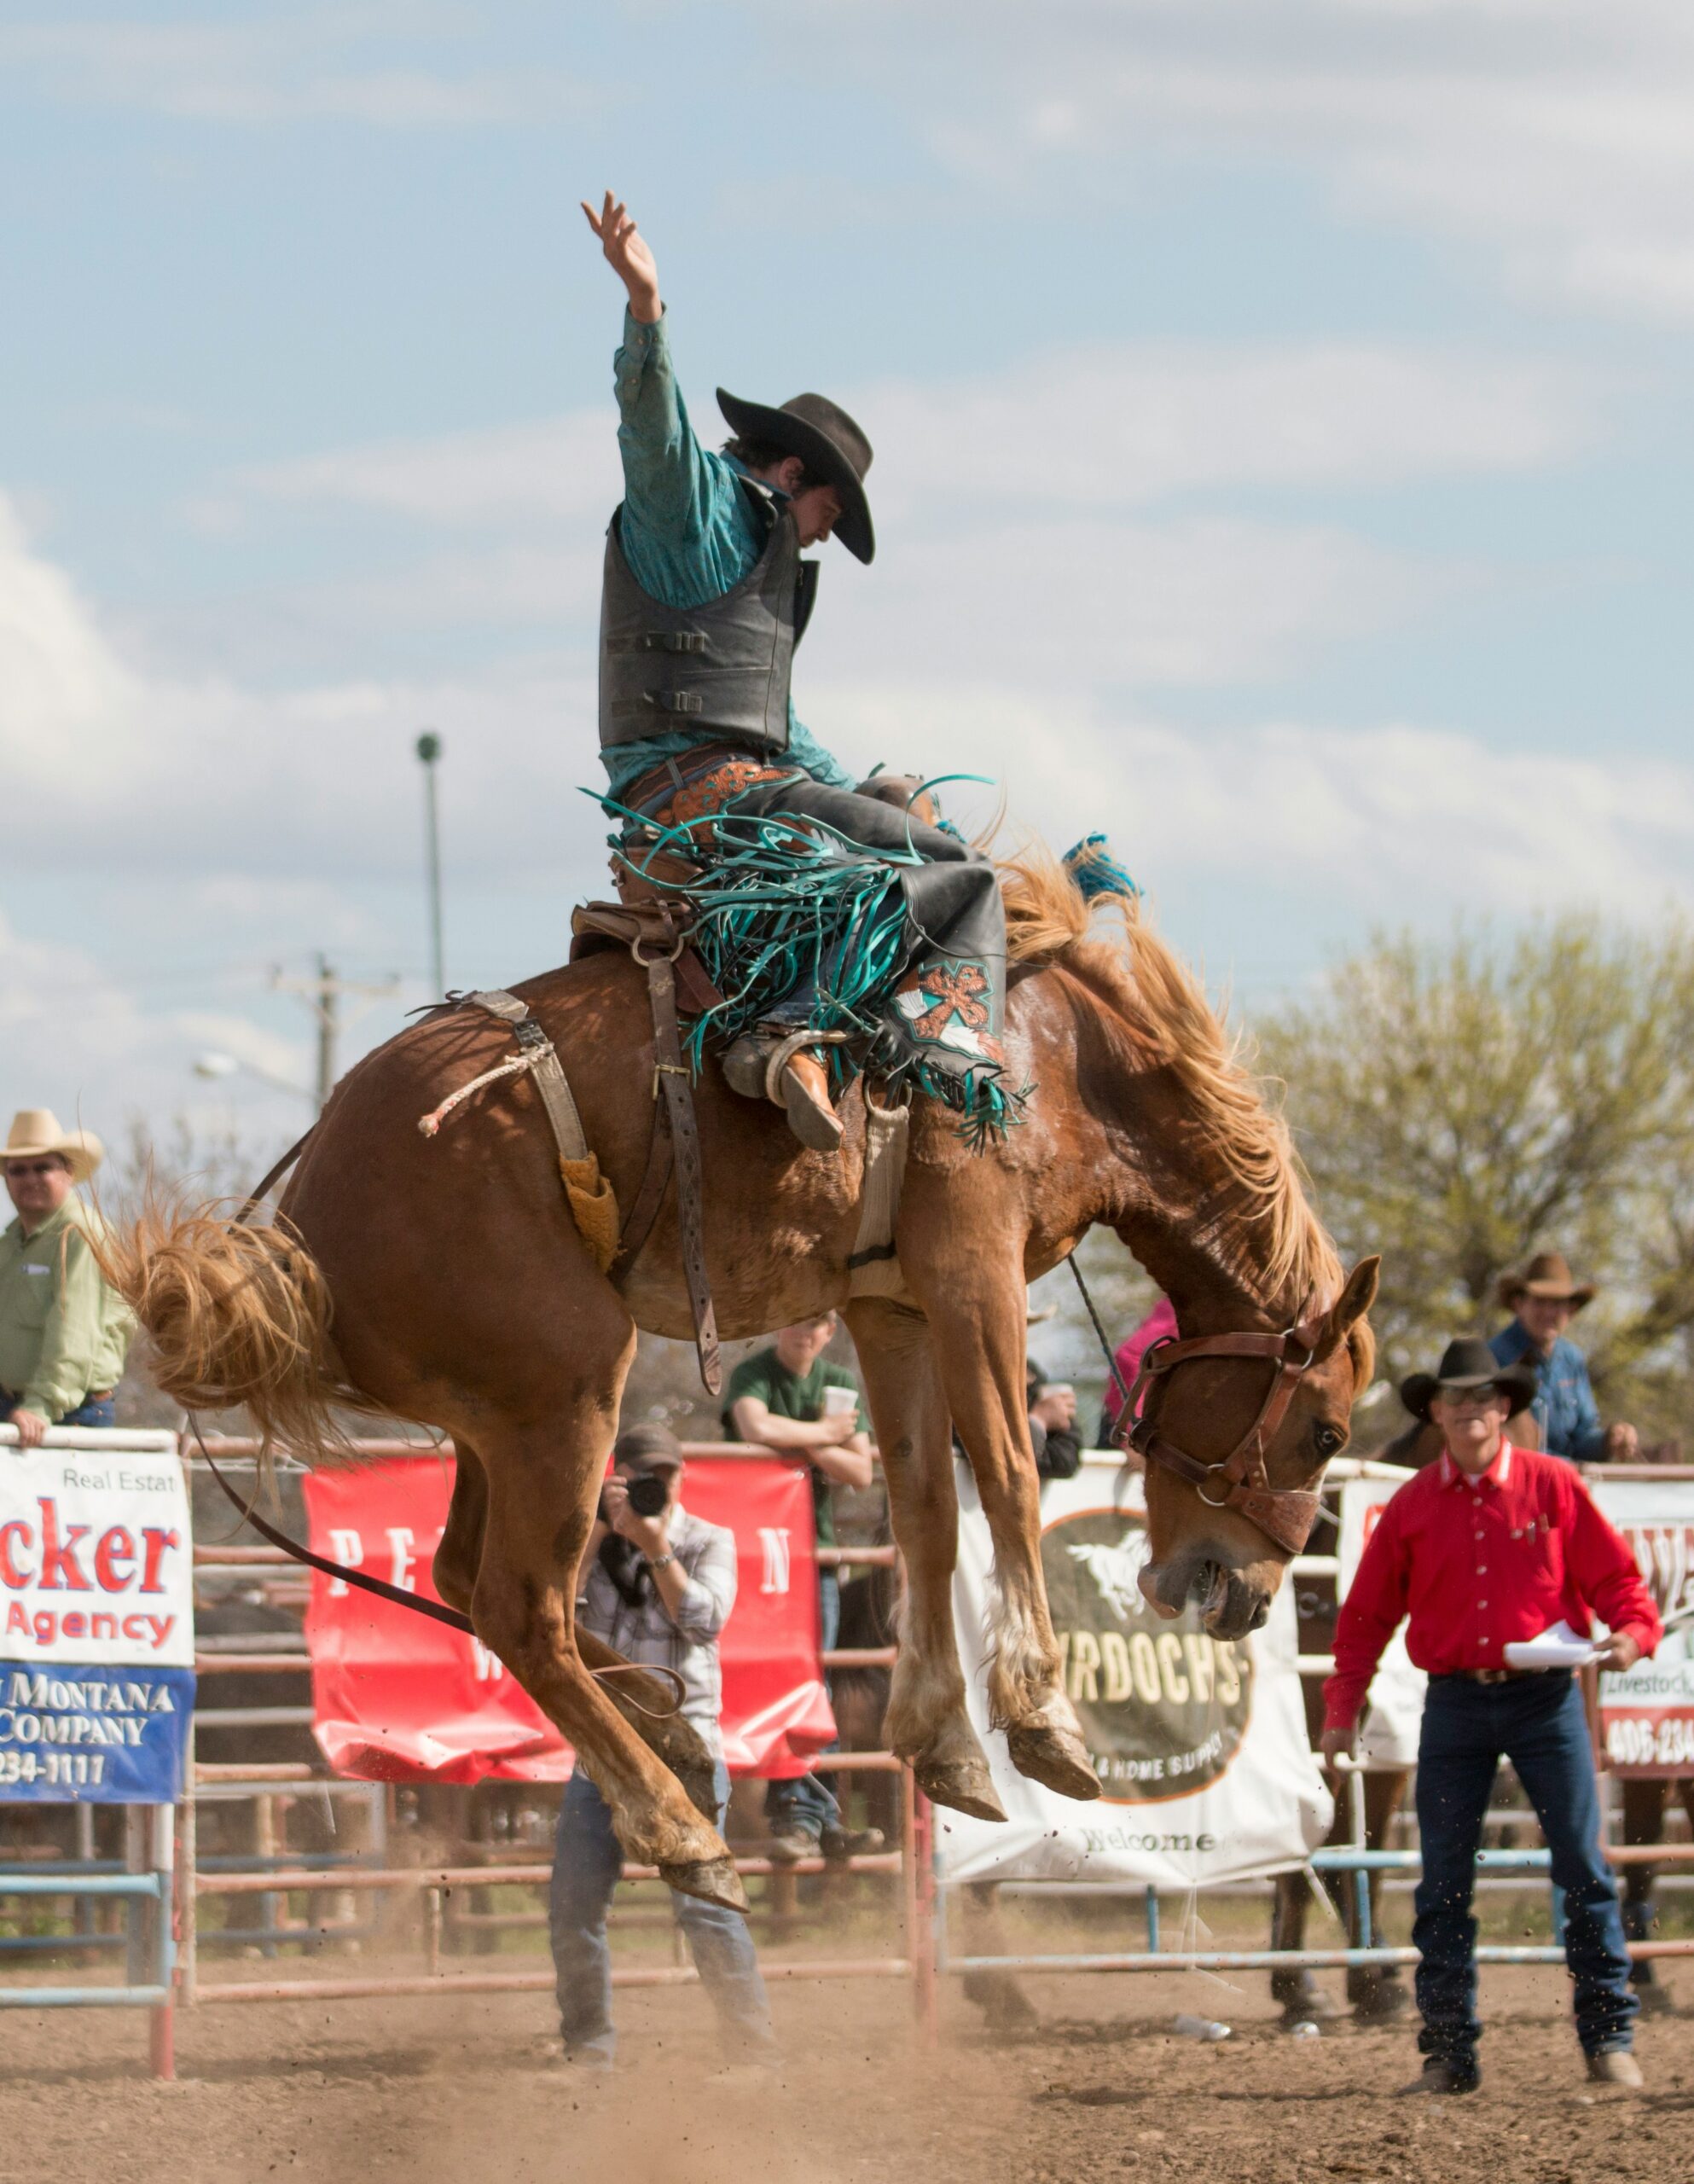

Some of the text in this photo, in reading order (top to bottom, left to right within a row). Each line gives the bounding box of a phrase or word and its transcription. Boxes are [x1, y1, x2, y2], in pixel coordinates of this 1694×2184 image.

[62, 1467, 176, 1492] Real Estat
[5, 1600, 177, 1650] Agency
[6, 1671, 176, 1711] MONTANA
[1096, 1757, 1110, 1778] &
[1112, 1758, 1165, 1781] HOME
[1168, 1729, 1223, 1777] SUPPLY
[1080, 1827, 1216, 1853] Welcome
